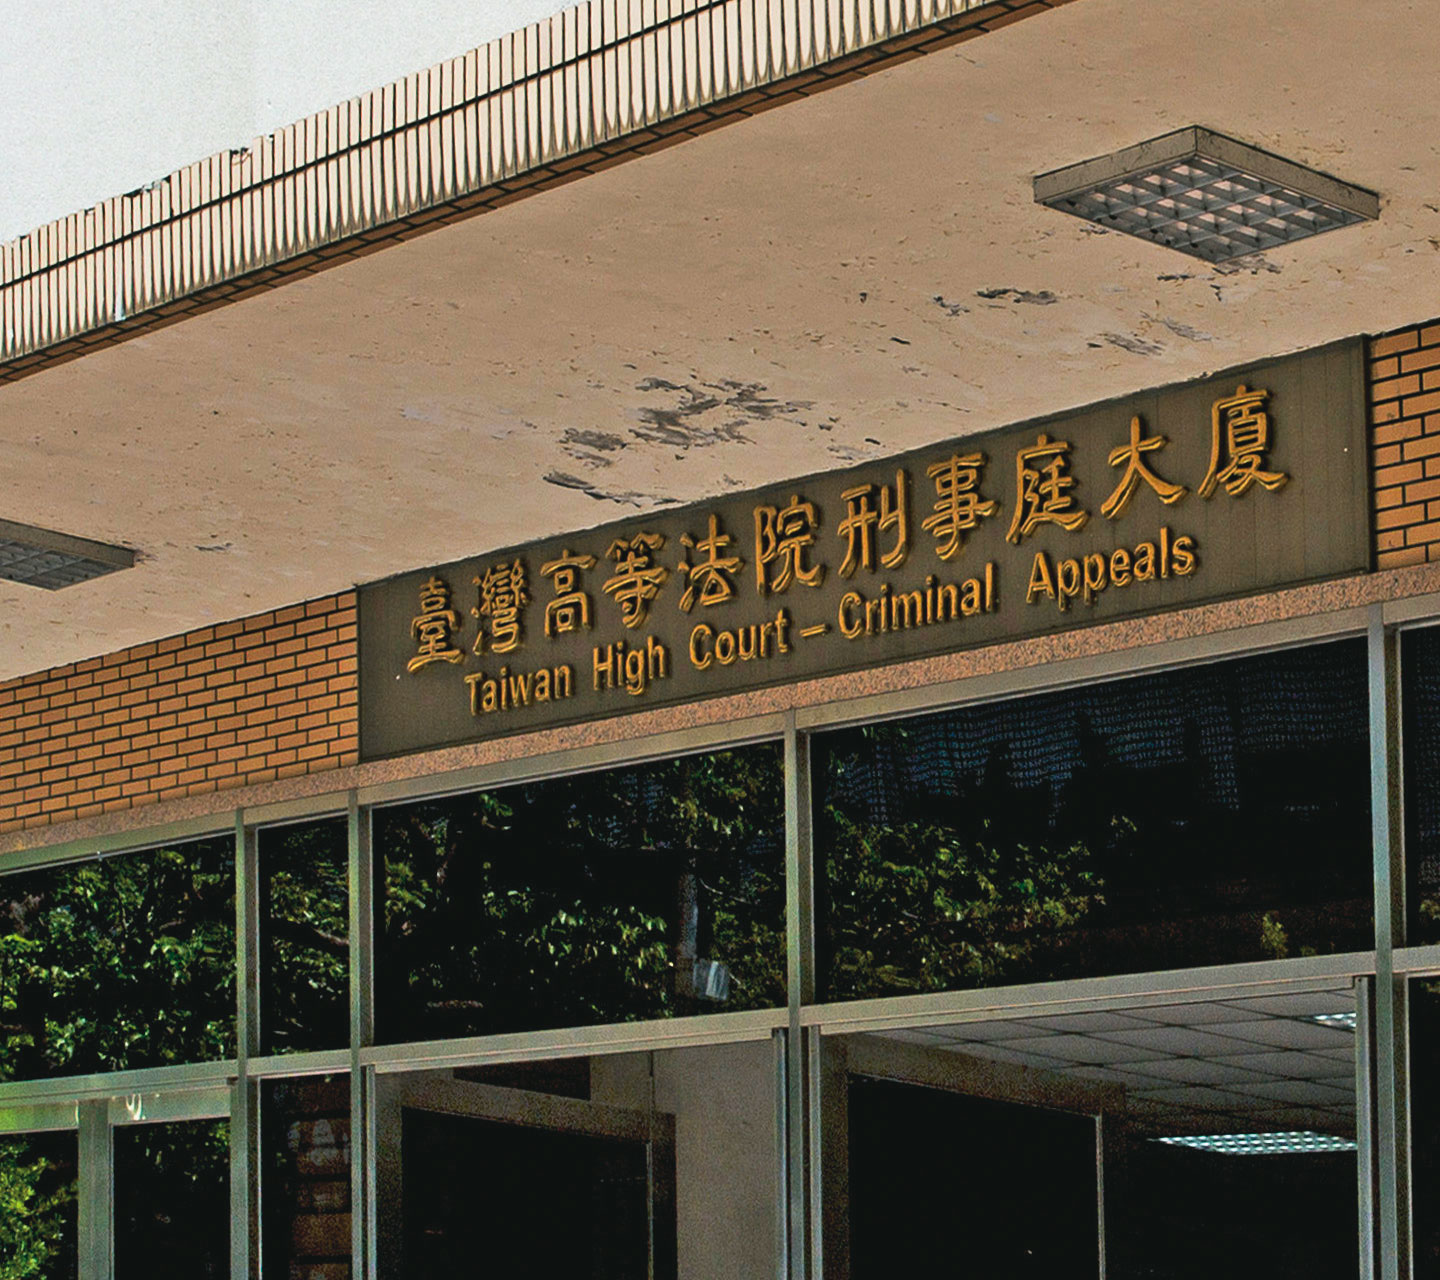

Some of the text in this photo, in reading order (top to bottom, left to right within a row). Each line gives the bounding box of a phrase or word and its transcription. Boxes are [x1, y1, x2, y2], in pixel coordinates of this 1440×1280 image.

[406, 384, 1289, 674] 臺灣高等法院刑事庭大廈
[464, 663, 574, 716] Taiwan
[592, 635, 667, 696] High
[688, 608, 789, 670] Court
[838, 562, 995, 639] Criminal
[1026, 526, 1199, 611] Appeals
